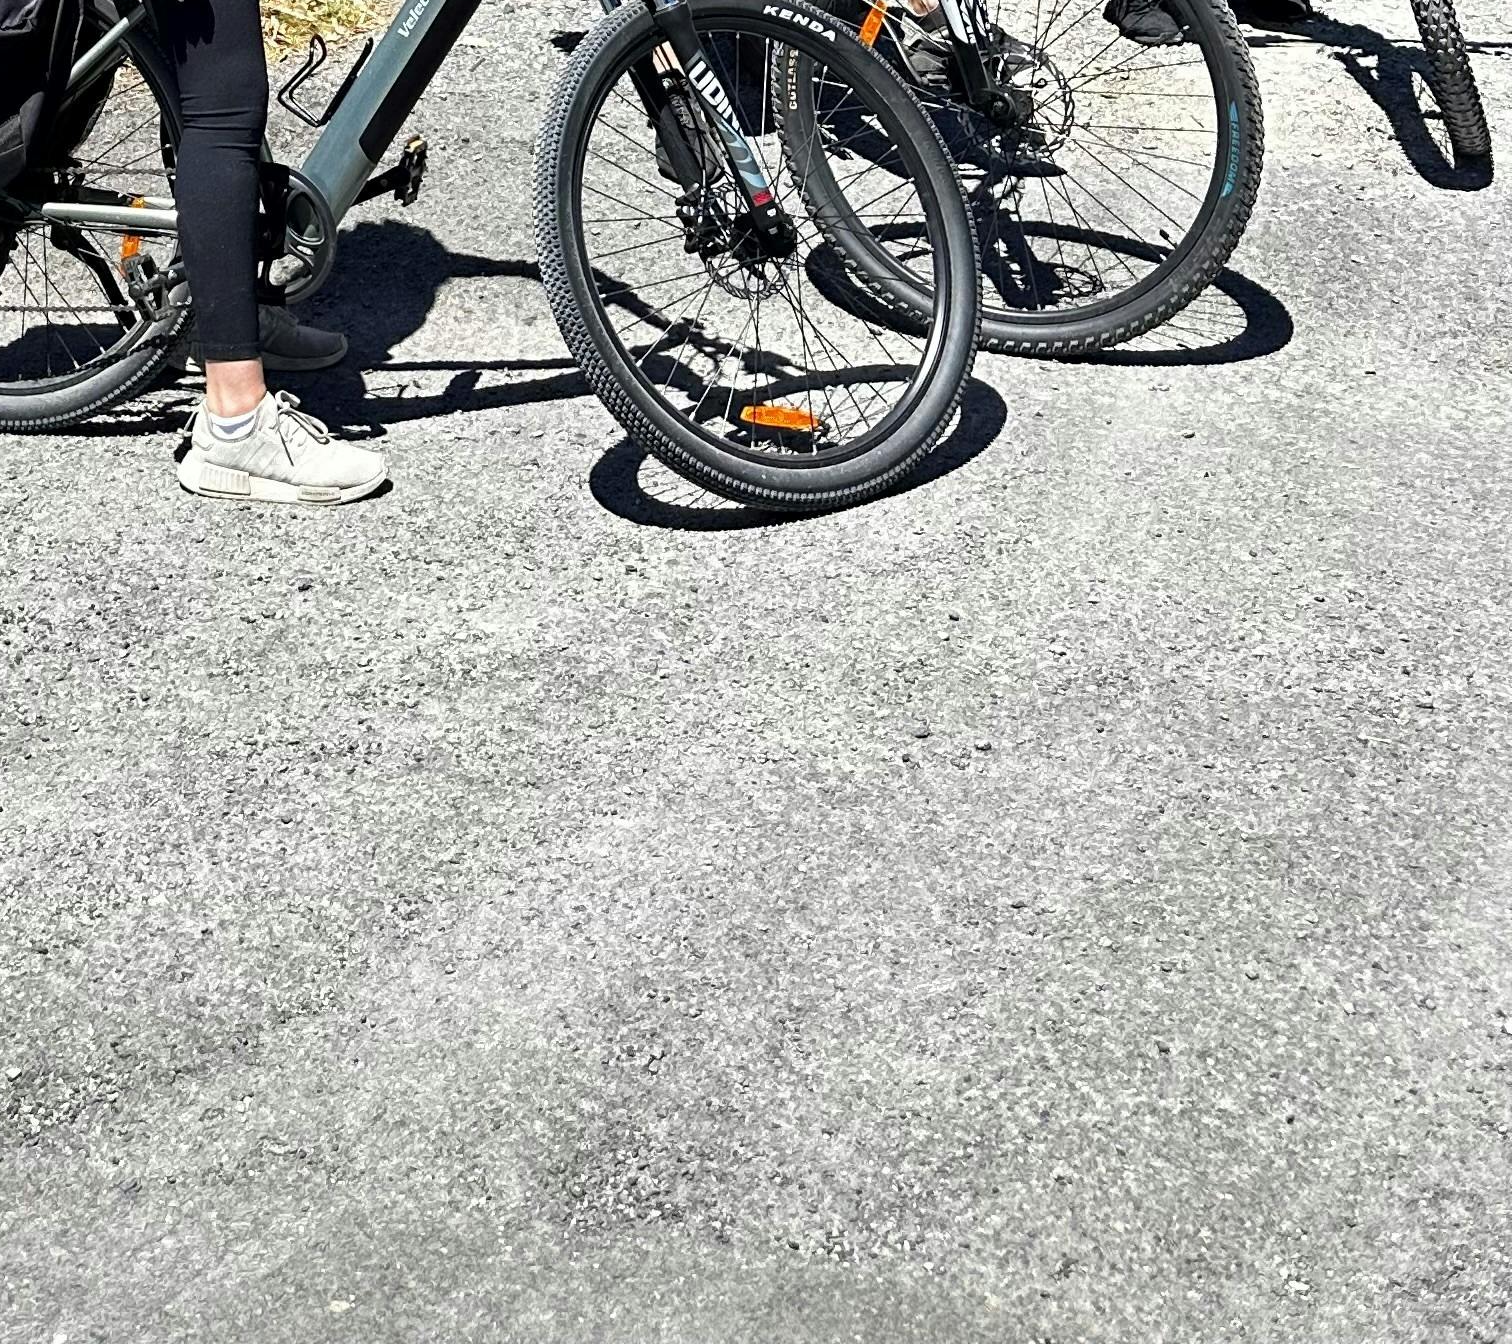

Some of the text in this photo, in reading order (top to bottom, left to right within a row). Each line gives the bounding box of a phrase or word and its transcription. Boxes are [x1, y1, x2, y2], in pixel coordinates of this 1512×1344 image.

[763, 5, 836, 43] KENDA
[688, 60, 746, 140] UDIN
[1227, 122, 1240, 184] FREEDOM
